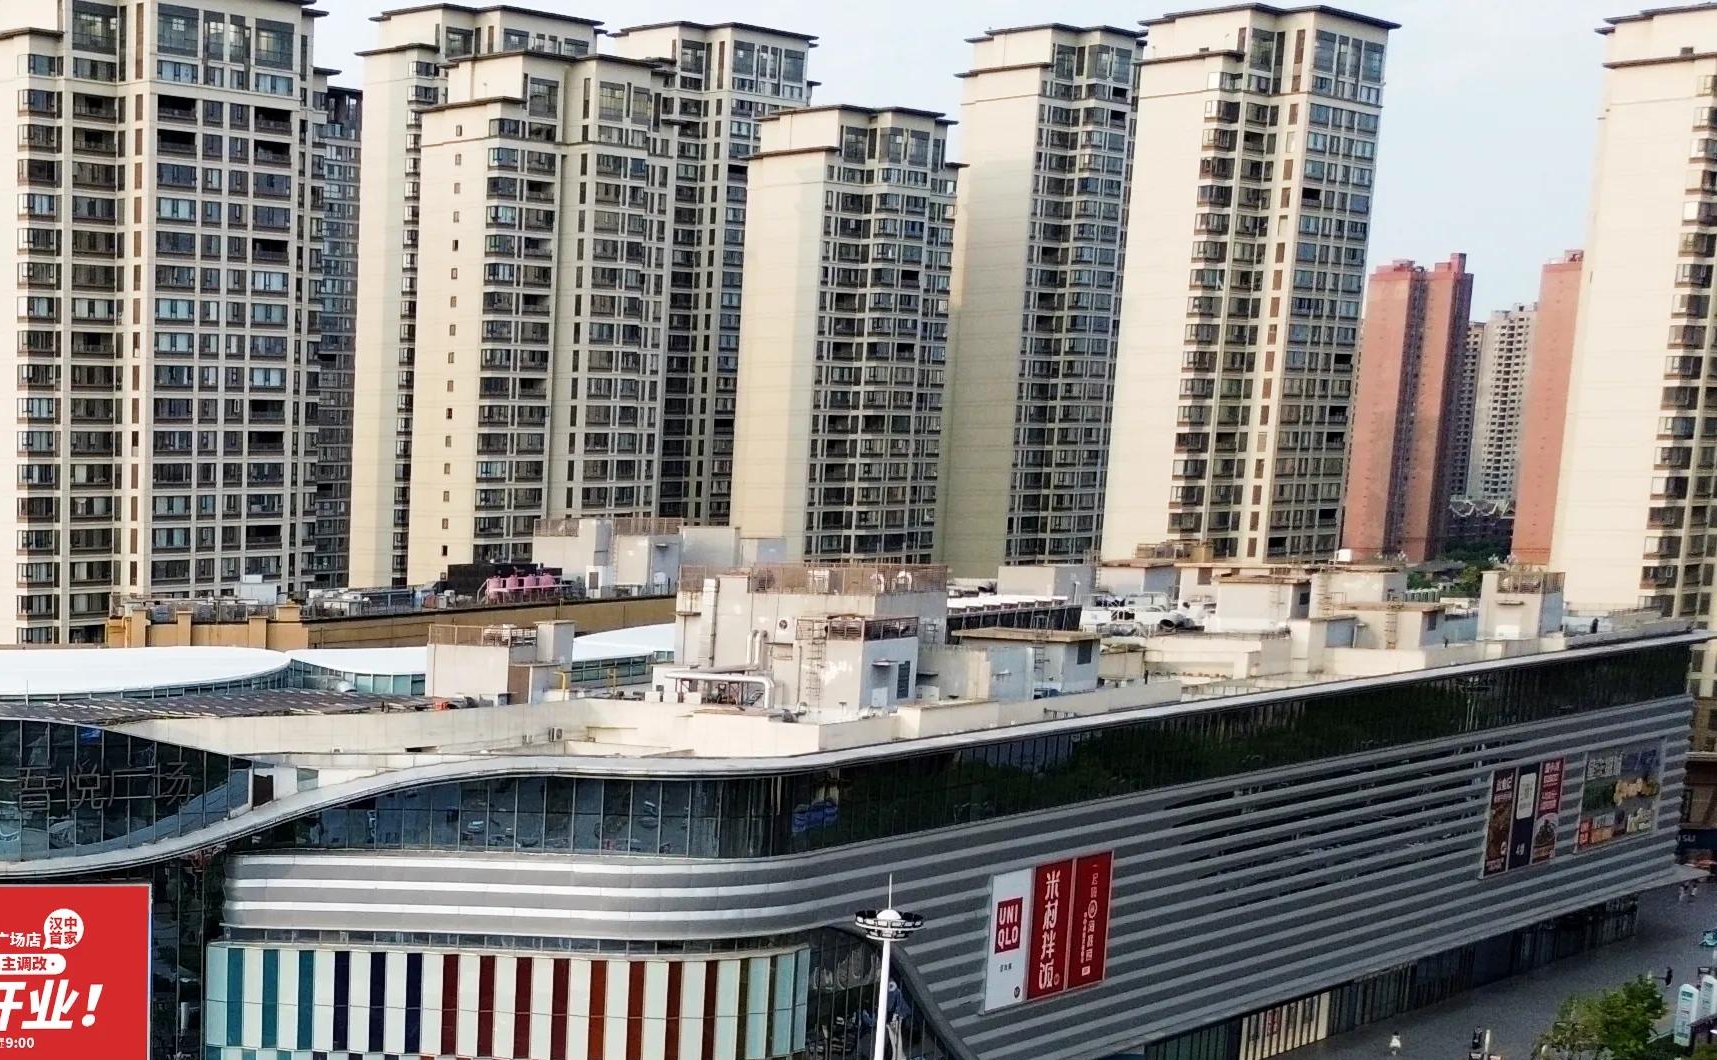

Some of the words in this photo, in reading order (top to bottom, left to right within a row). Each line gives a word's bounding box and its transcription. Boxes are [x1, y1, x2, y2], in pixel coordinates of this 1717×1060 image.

[16, 759, 193, 811] 吾悦广场
[49, 916, 78, 930] 汉中
[998, 904, 1019, 926] UNI
[49, 931, 78, 945] 首家
[997, 925, 1019, 949] QLO
[1038, 869, 1061, 990] 米村拌饭
